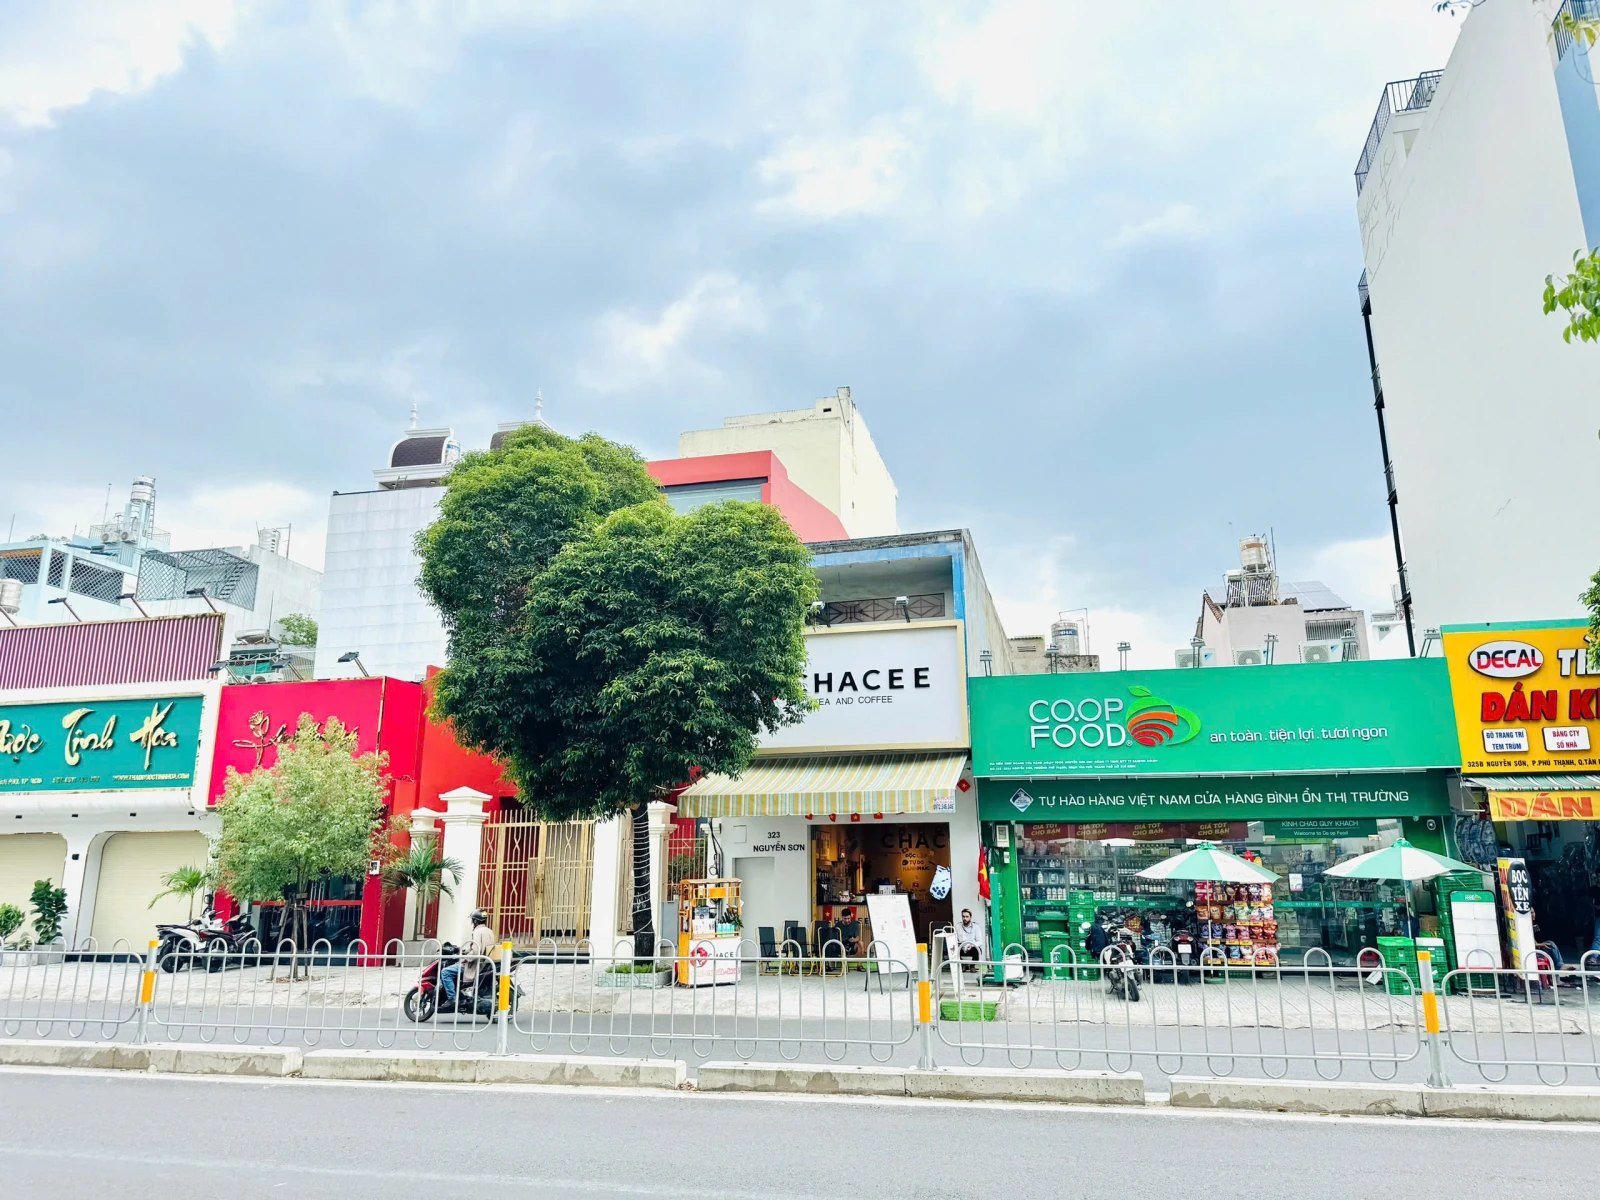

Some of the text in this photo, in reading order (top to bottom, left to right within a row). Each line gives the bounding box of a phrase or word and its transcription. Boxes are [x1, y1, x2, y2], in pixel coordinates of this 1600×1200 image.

[1476, 648, 1542, 669] DECAL
[1557, 634, 1600, 676] TI
[803, 667, 931, 693] HACEE
[816, 695, 893, 706] EA AND COFFEE
[1481, 681, 1558, 721] DÁN
[1569, 688, 1600, 721] K
[1029, 698, 1124, 723] CO.OP
[130, 701, 178, 771] Hoa
[1030, 723, 1127, 748] FOOD
[1210, 727, 1388, 743] an toàn tiện lợi tươi ngon
[1496, 730, 1514, 739] TRANG
[1569, 729, 1580, 737] CTY
[1492, 743, 1505, 751] TEM
[1556, 740, 1565, 749] SỐ
[1487, 758, 1512, 767] NGUYỄN
[1038, 796, 1056, 808] TỰ
[1060, 794, 1086, 806] HÀO
[1088, 793, 1125, 806] HÀNG
[1128, 793, 1156, 808] VIỆT
[1160, 795, 1191, 805] NAM
[1194, 790, 1222, 805] CỬA
[1225, 792, 1263, 804] HÀNG
[1267, 791, 1299, 804] BÌNH
[1302, 787, 1321, 803] ỔN
[1325, 791, 1347, 804] THỊ
[1351, 789, 1409, 803] TRƯỜNG
[1499, 792, 1594, 818] DÁN
[767, 831, 781, 839] 323
[752, 841, 805, 852] NGUYỄN SƠN
[1515, 901, 1531, 911] XE
